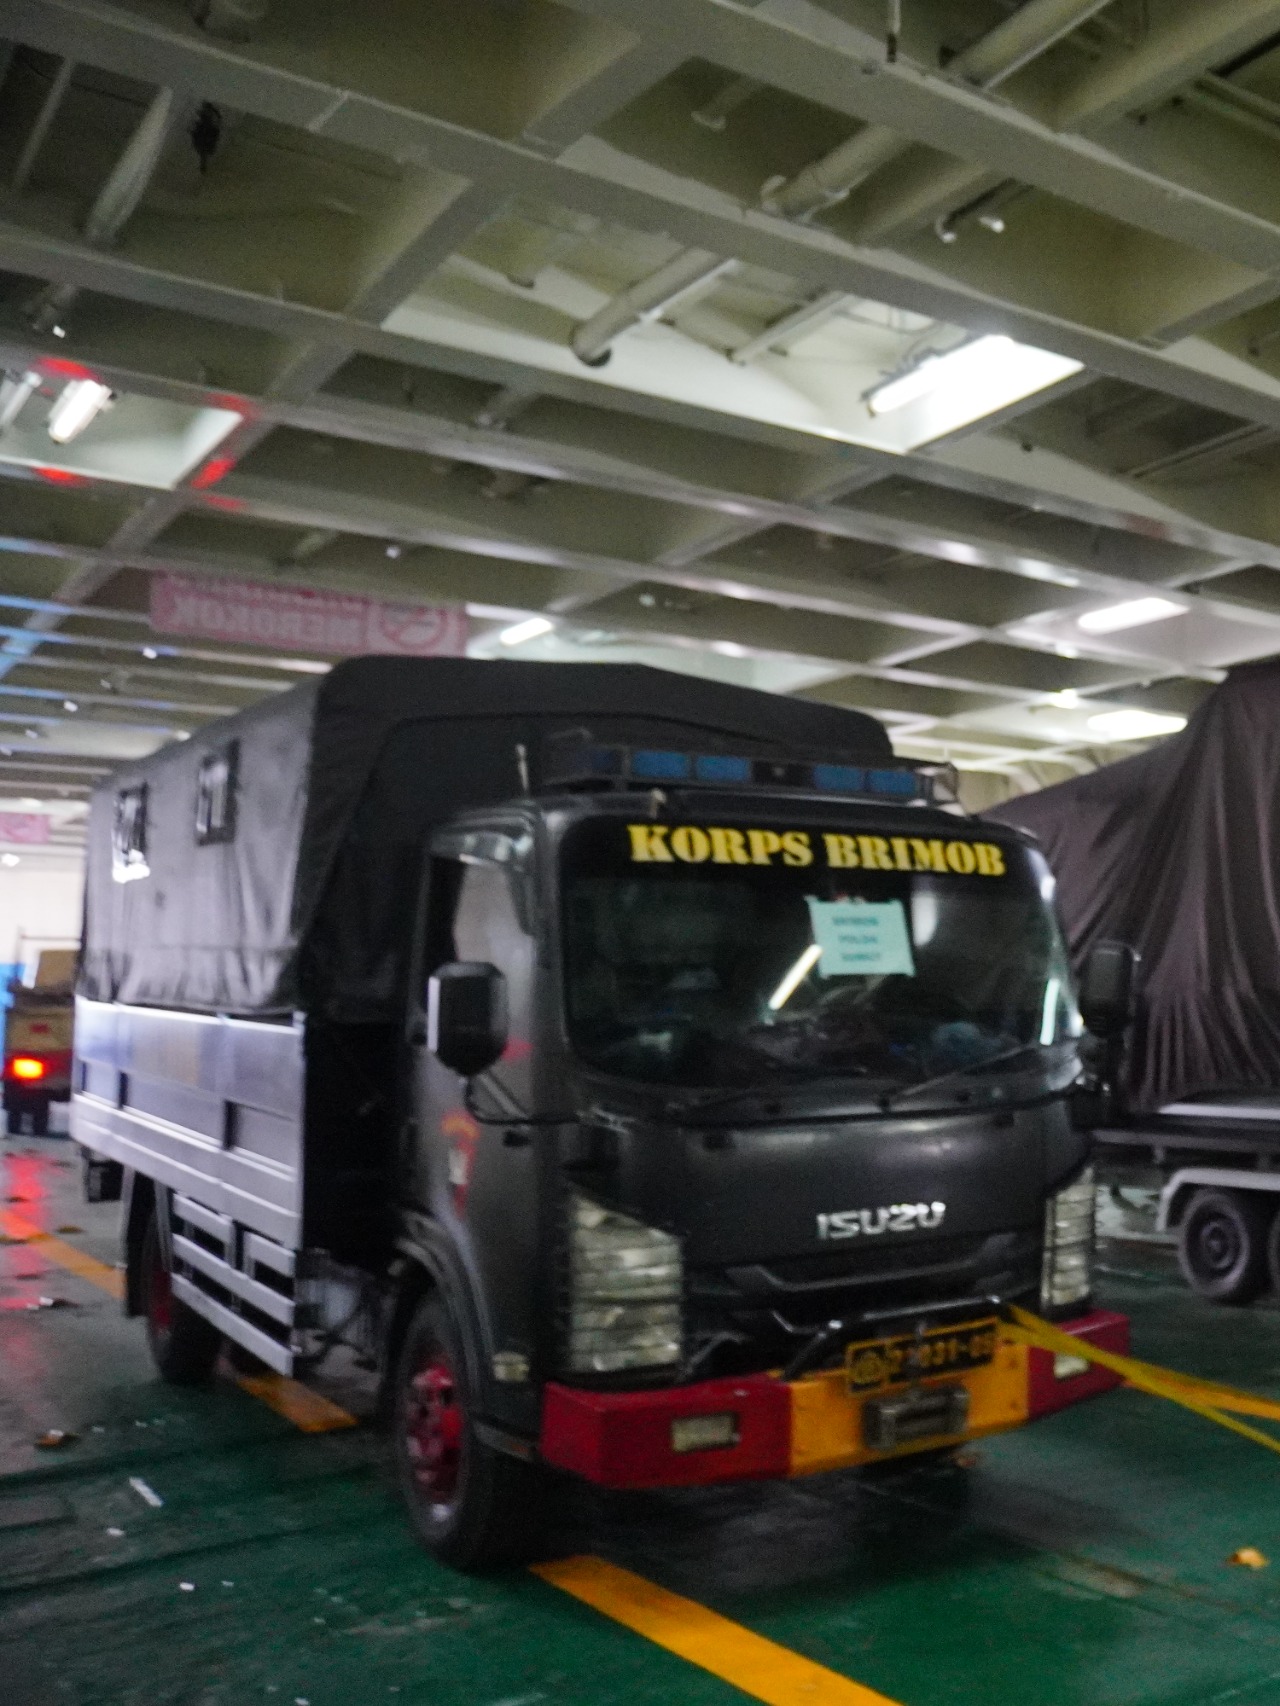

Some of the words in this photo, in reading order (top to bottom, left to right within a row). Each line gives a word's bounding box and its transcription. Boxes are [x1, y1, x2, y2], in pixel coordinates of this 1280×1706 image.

[626, 824, 813, 867] KORPS
[822, 832, 1006, 877] BRIMOB
[816, 1201, 946, 1240] ISUZU
